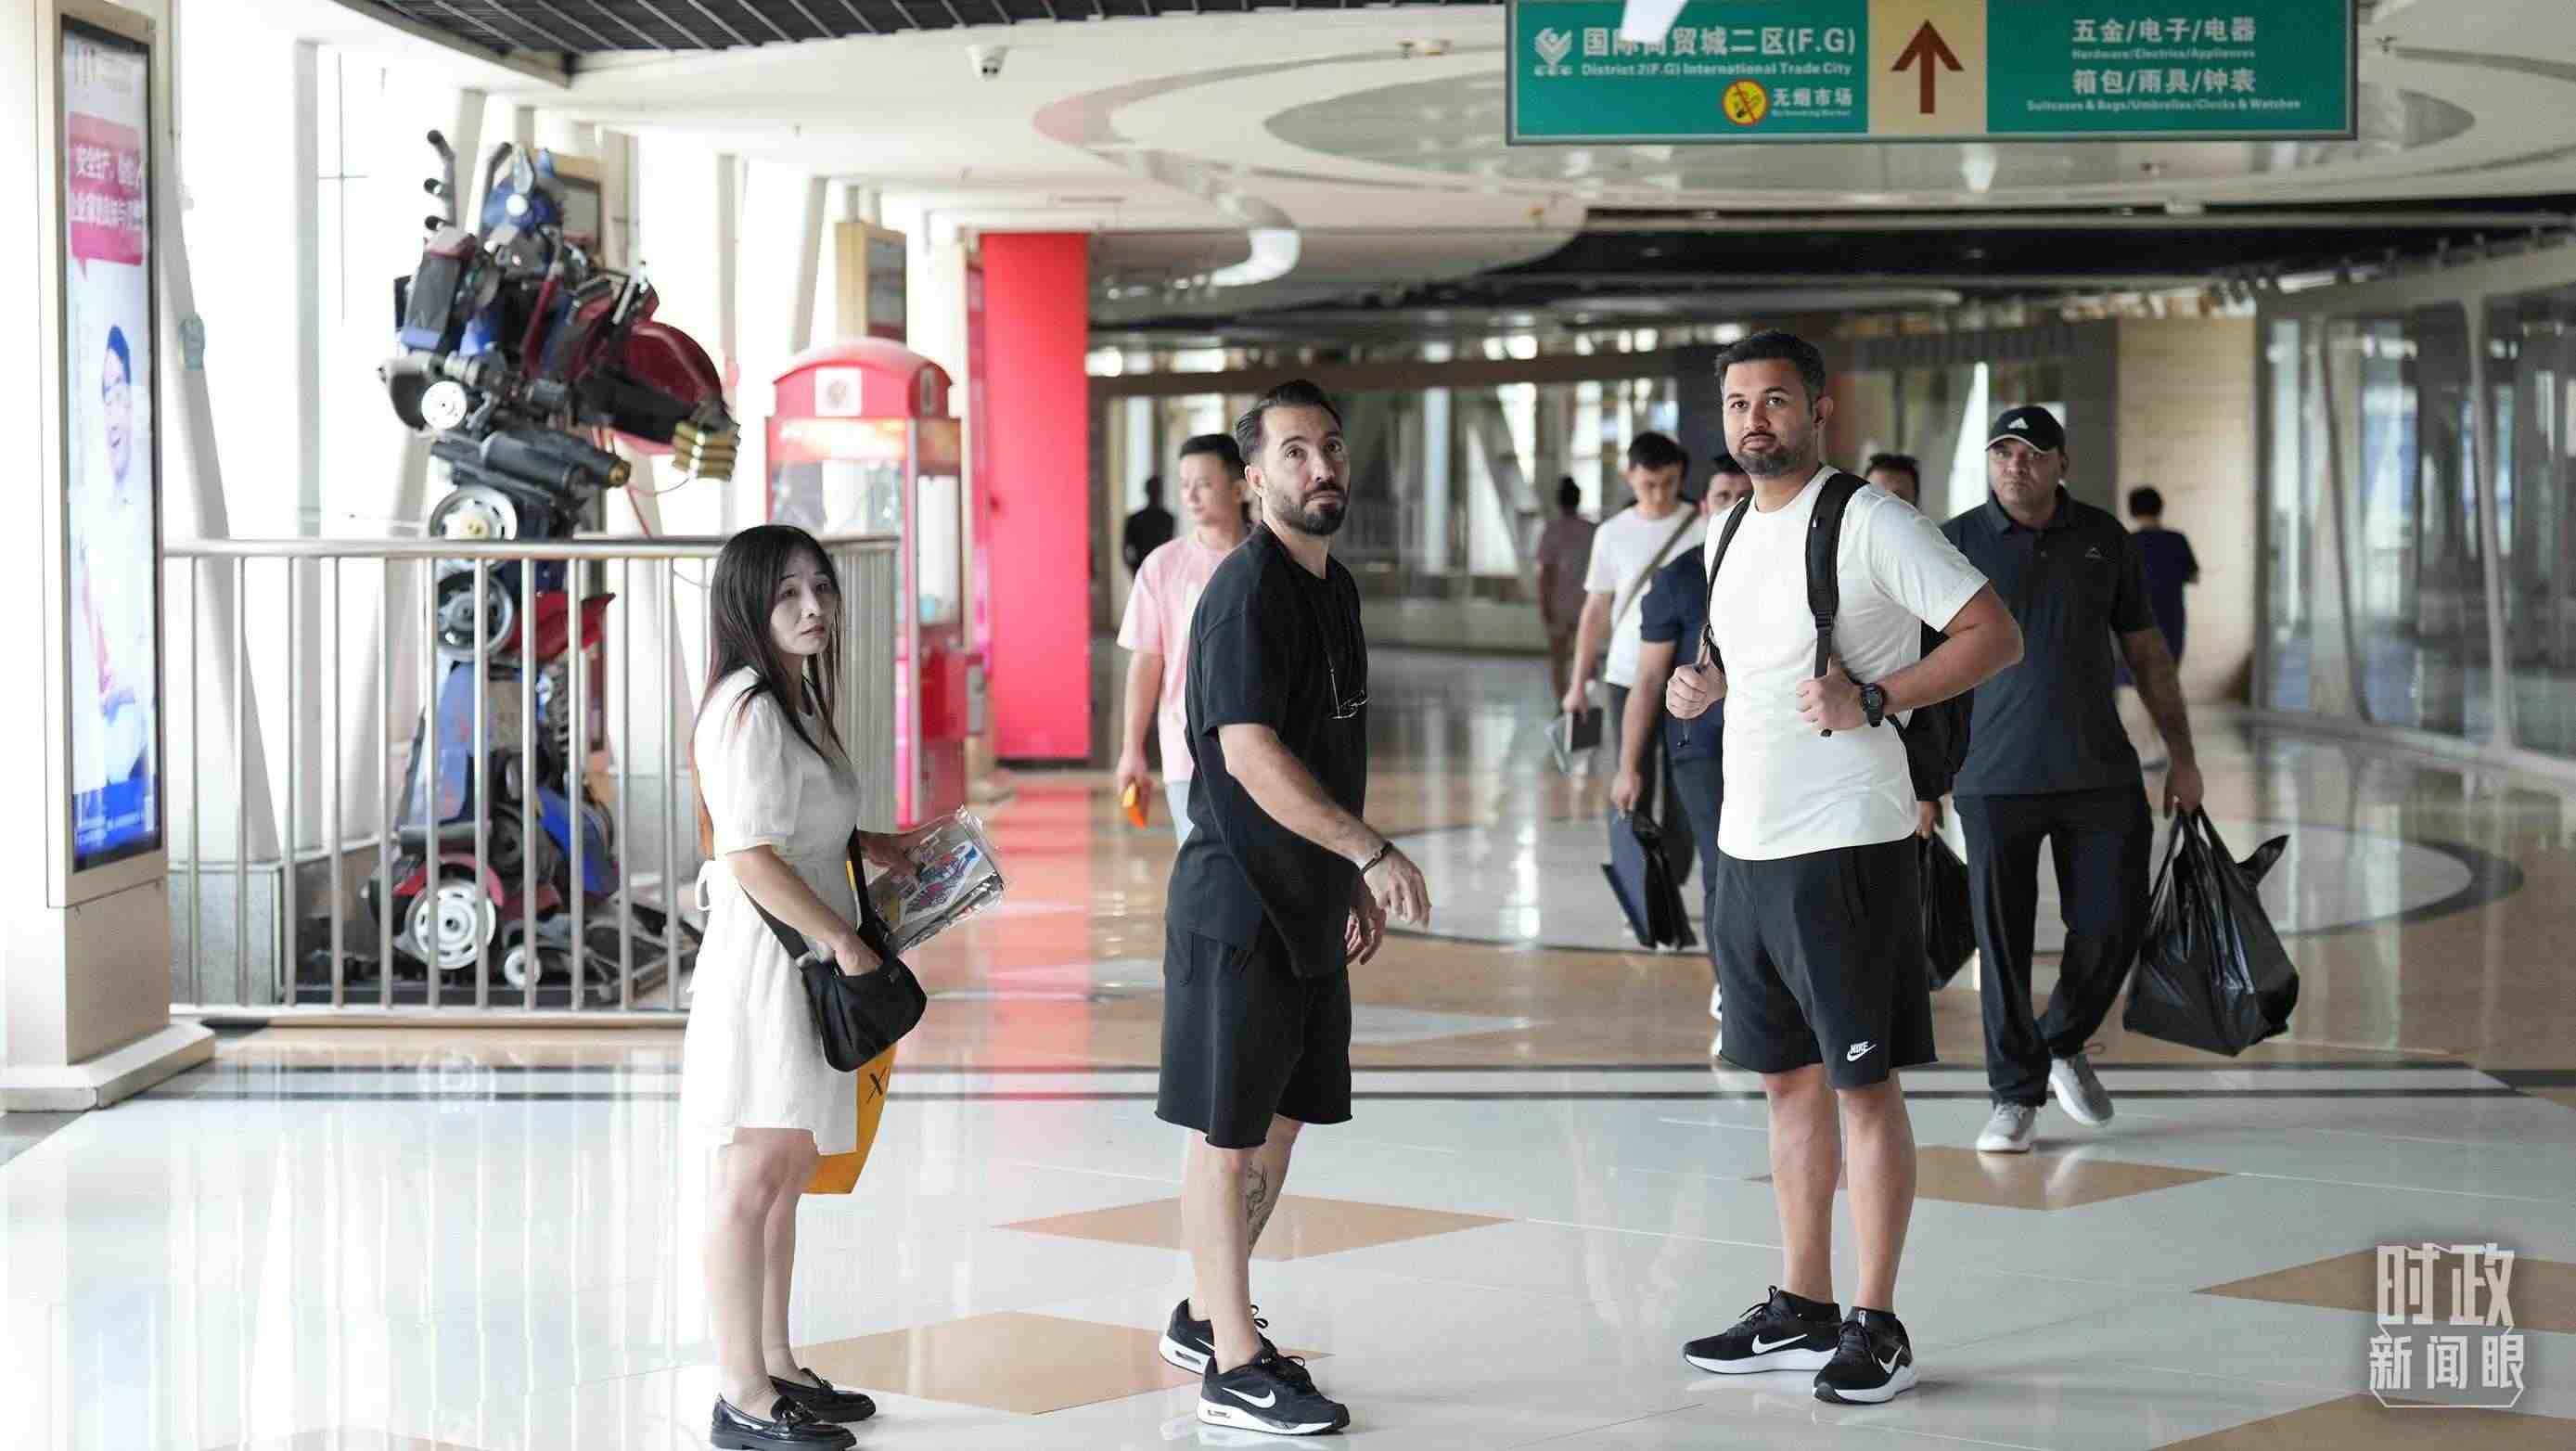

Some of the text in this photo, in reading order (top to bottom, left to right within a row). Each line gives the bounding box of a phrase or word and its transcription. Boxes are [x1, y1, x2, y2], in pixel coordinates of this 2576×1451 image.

[2072, 17, 2256, 43] 五金/电子/电器
[1684, 62, 1776, 75] International
[1779, 62, 1820, 74] Trade
[1823, 62, 1852, 76] City
[2072, 68, 2256, 94] 箱包/雨具/钟表
[1773, 87, 1853, 107] 无烟市场
[1850, 1041, 1868, 1055] NIKE
